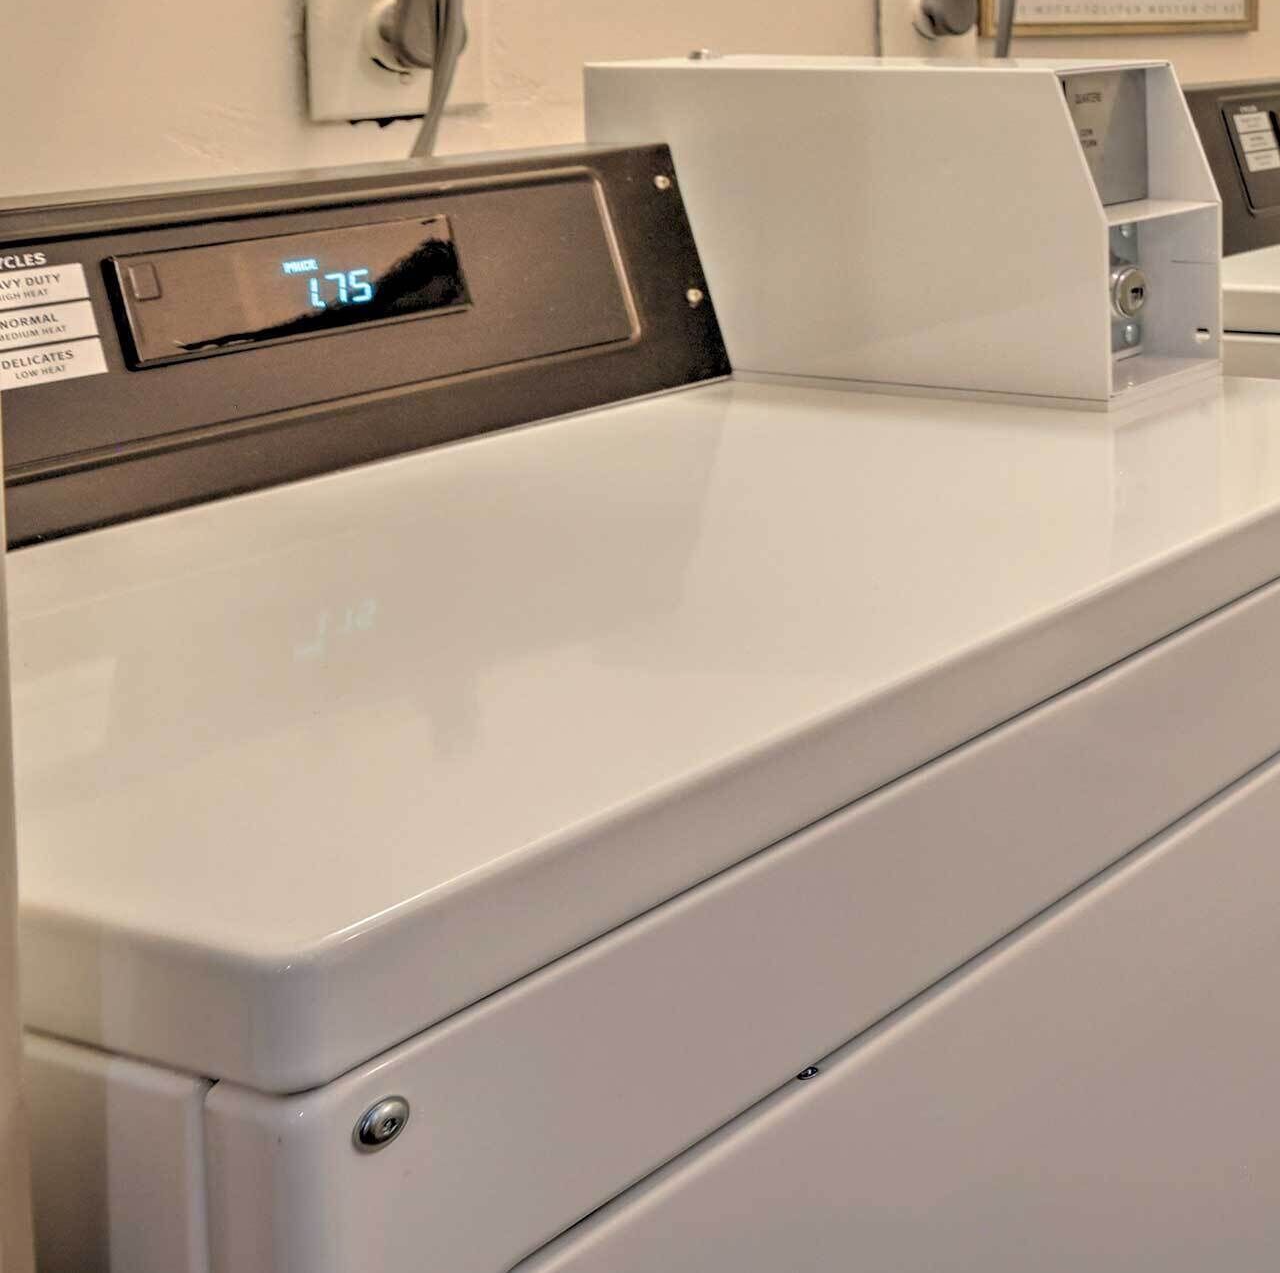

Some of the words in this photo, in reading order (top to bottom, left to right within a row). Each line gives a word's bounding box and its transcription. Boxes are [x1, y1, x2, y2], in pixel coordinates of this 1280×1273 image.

[25, 273, 61, 286] DUTY
[0, 313, 59, 330] NORMAL
[2, 350, 74, 370] DELICATES
[15, 370, 39, 380] LOW
